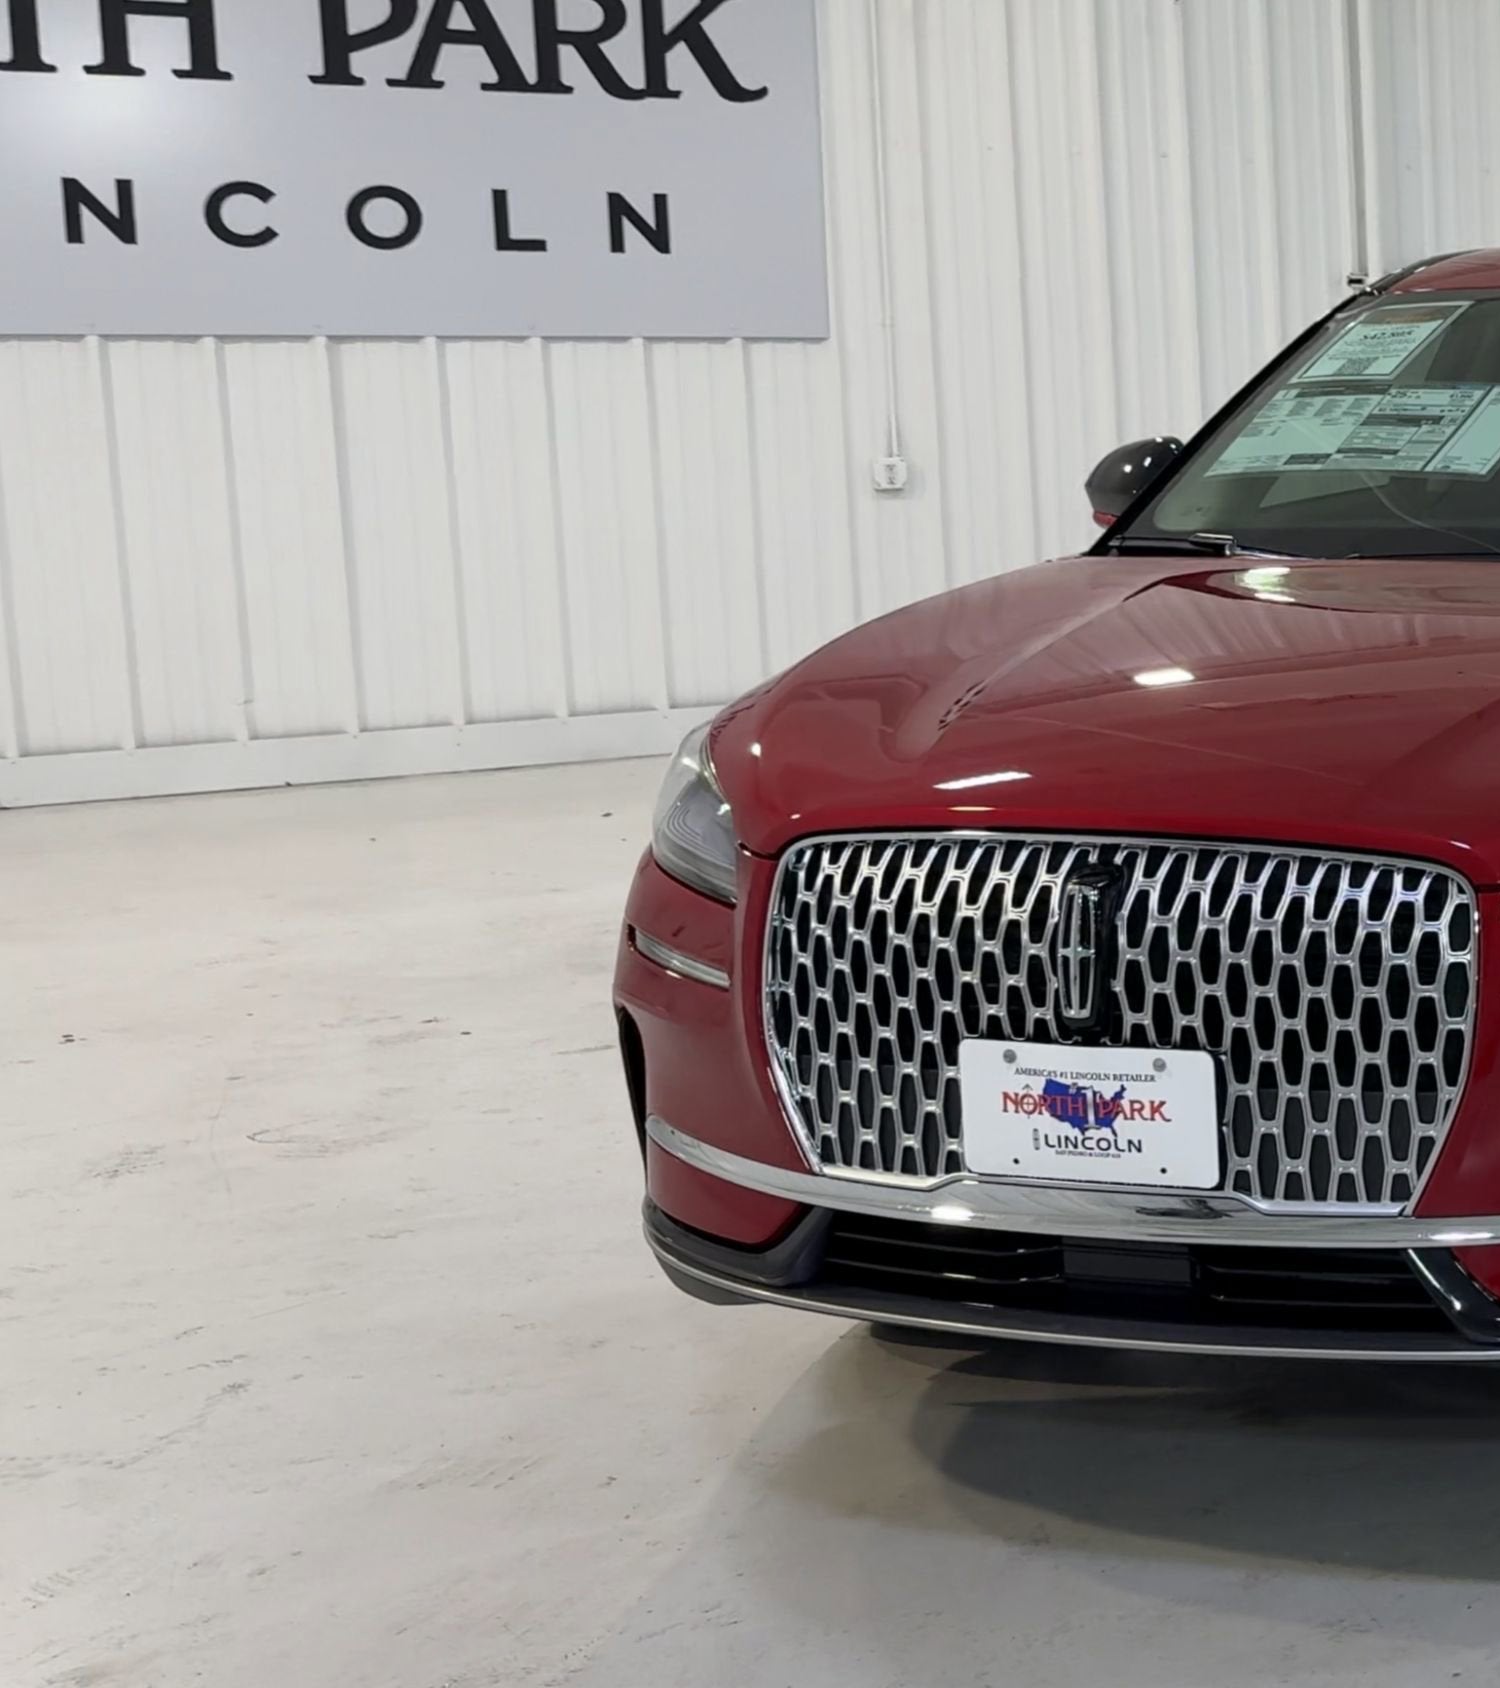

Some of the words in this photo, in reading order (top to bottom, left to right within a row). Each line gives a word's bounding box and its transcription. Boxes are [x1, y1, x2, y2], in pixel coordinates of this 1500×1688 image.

[307, 0, 769, 103] PARK
[1014, 1067, 1058, 1079] AMERICA'S
[1070, 1072, 1111, 1081] LINCOLN
[1112, 1073, 1157, 1083] RETAILER
[1002, 1090, 1085, 1117] NORTH
[1099, 1098, 1172, 1122] PARK
[1044, 1133, 1143, 1153] LINCOLN
